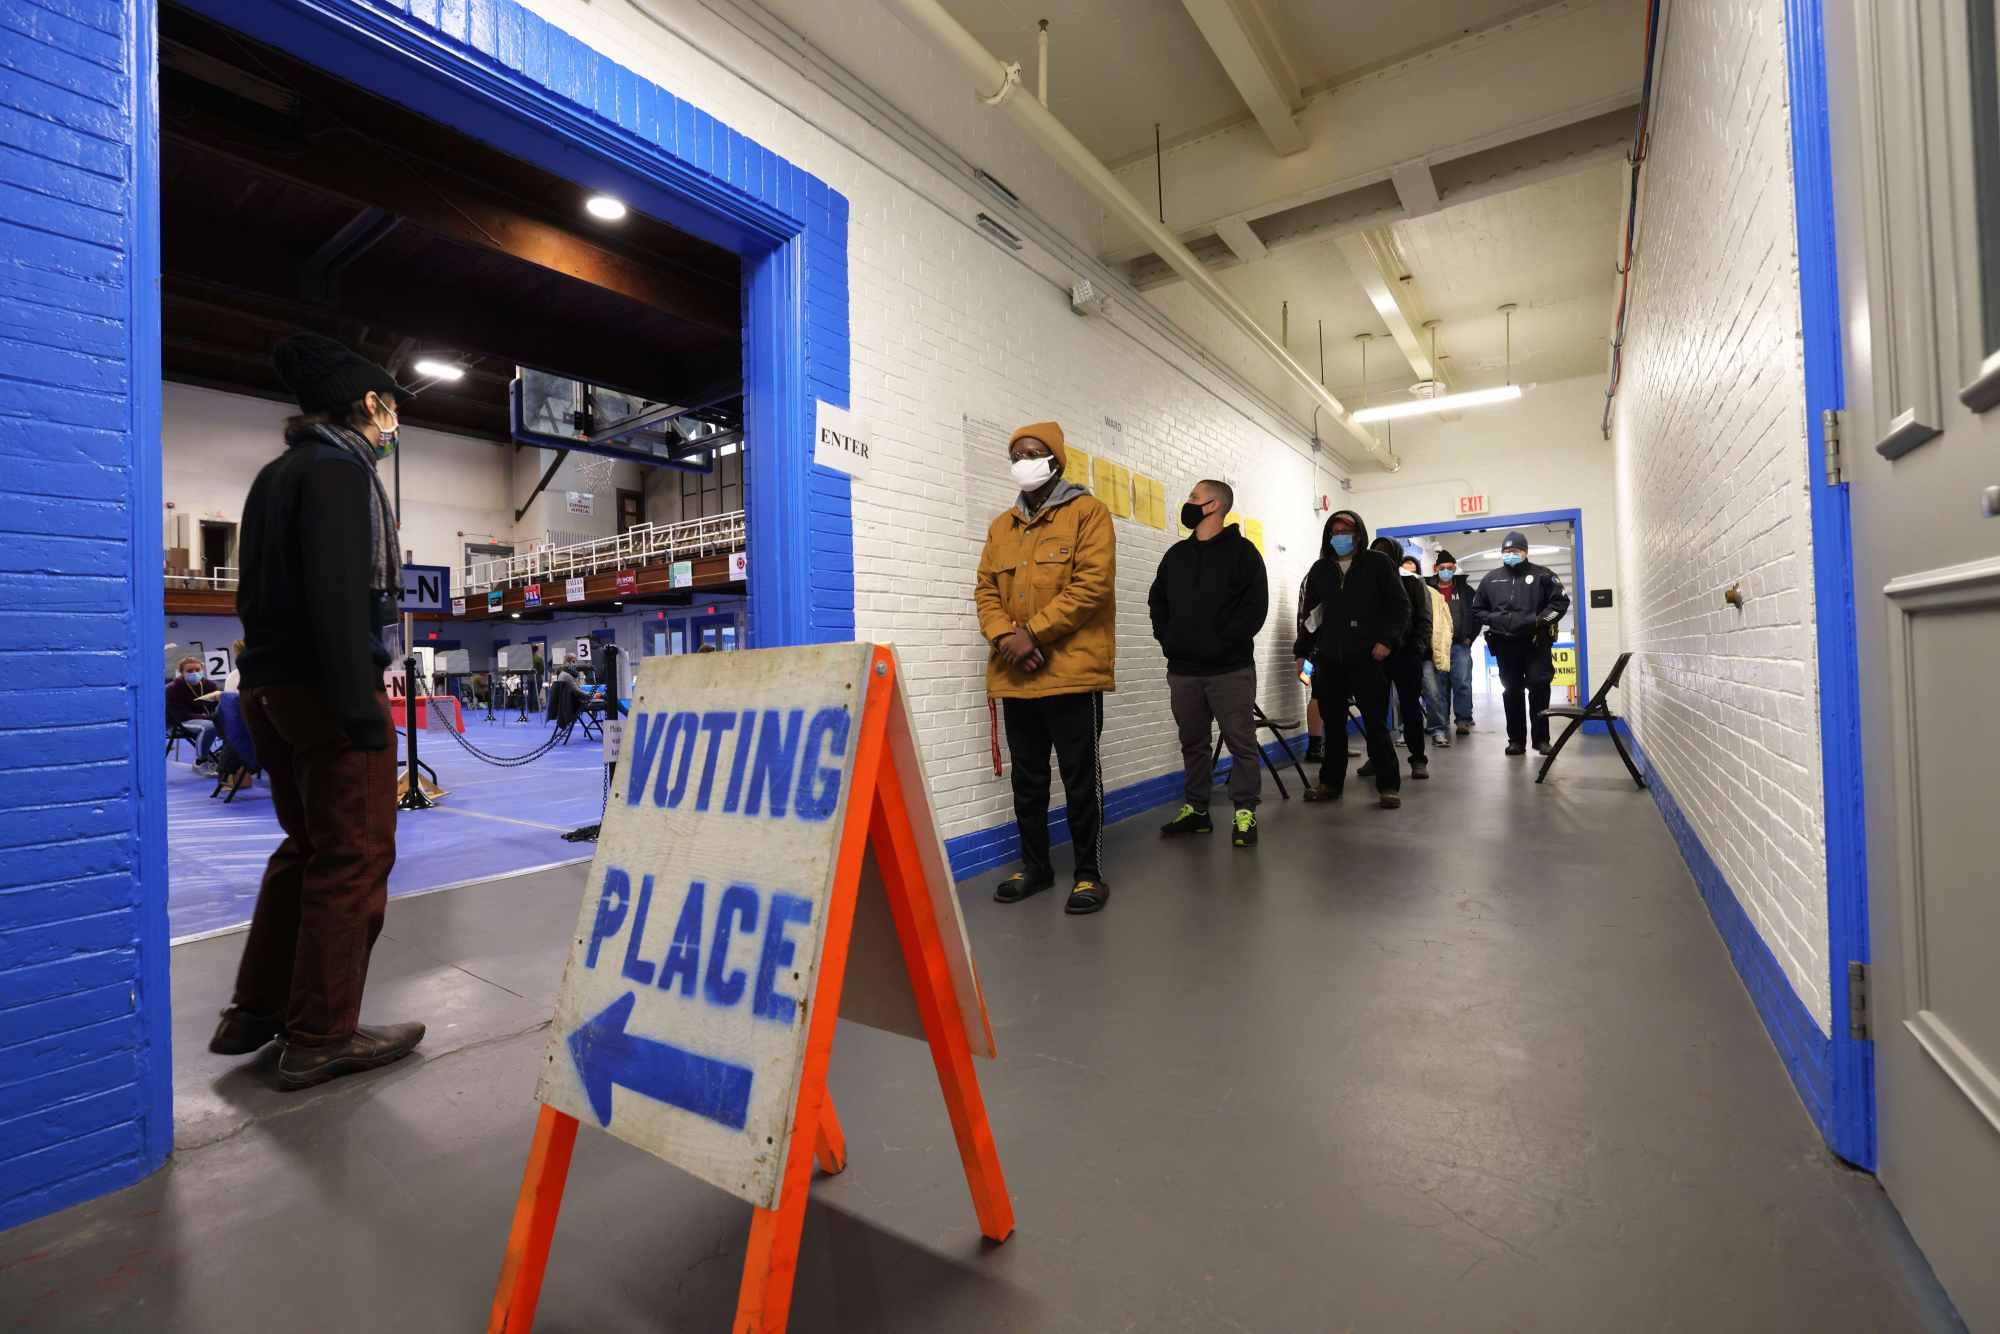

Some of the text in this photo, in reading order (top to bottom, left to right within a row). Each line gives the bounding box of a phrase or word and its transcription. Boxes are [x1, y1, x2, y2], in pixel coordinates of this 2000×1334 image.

[821, 427, 869, 459] ENTER
[1460, 496, 1483, 512] EXIT
[579, 643, 589, 657] 3
[209, 657, 226, 675] 2
[627, 707, 850, 821] VOTING
[585, 868, 813, 1022] PLACE
